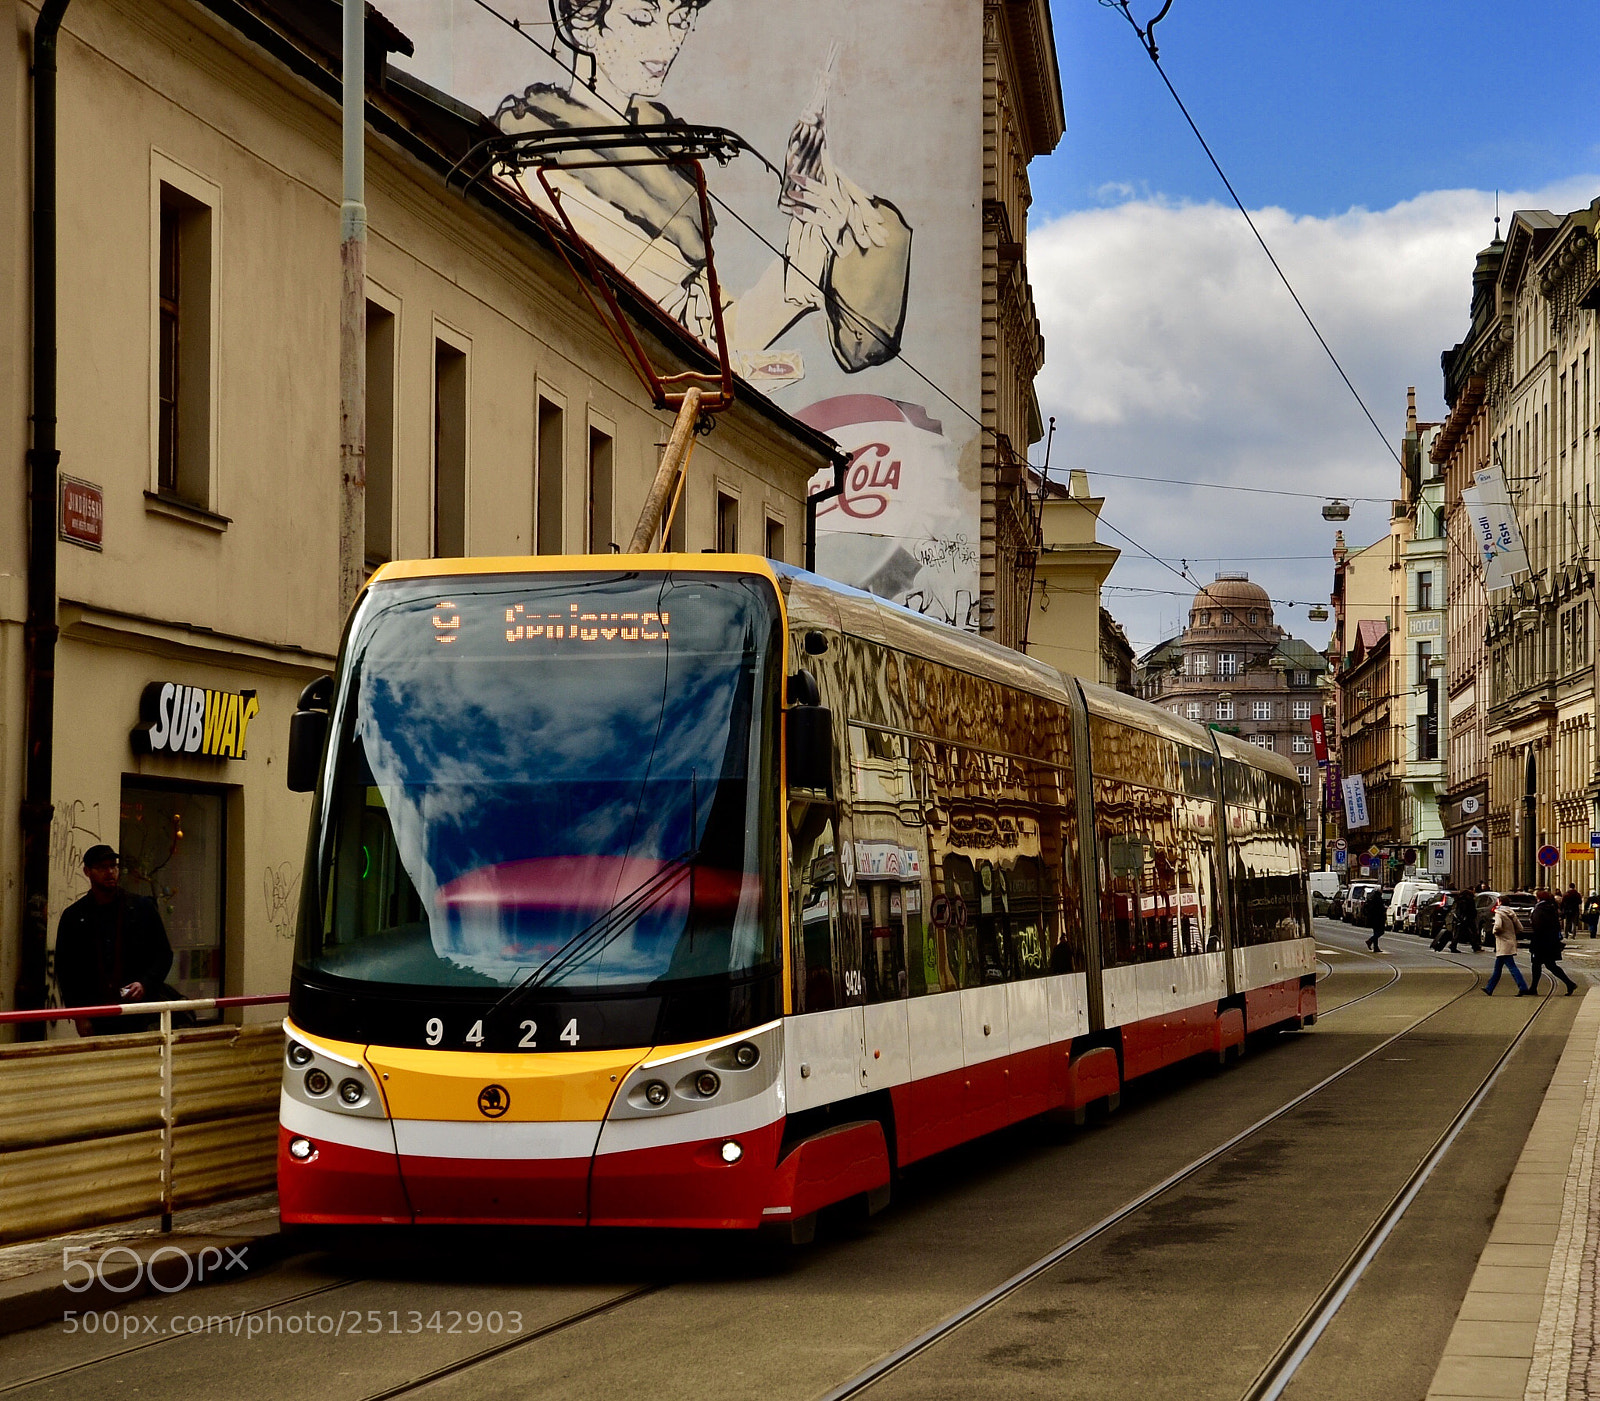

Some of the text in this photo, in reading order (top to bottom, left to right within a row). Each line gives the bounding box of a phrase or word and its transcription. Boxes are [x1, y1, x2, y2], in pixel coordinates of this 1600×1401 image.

[838, 443, 901, 519] COLA
[1478, 516, 1494, 541] bidli
[1498, 522, 1512, 546] RSH
[1409, 619, 1439, 634] HOTEL
[149, 682, 259, 759] SUBWAY
[1428, 716, 1437, 735] NYX
[1353, 779, 1365, 821] CRESTYL
[845, 969, 862, 997] 9424
